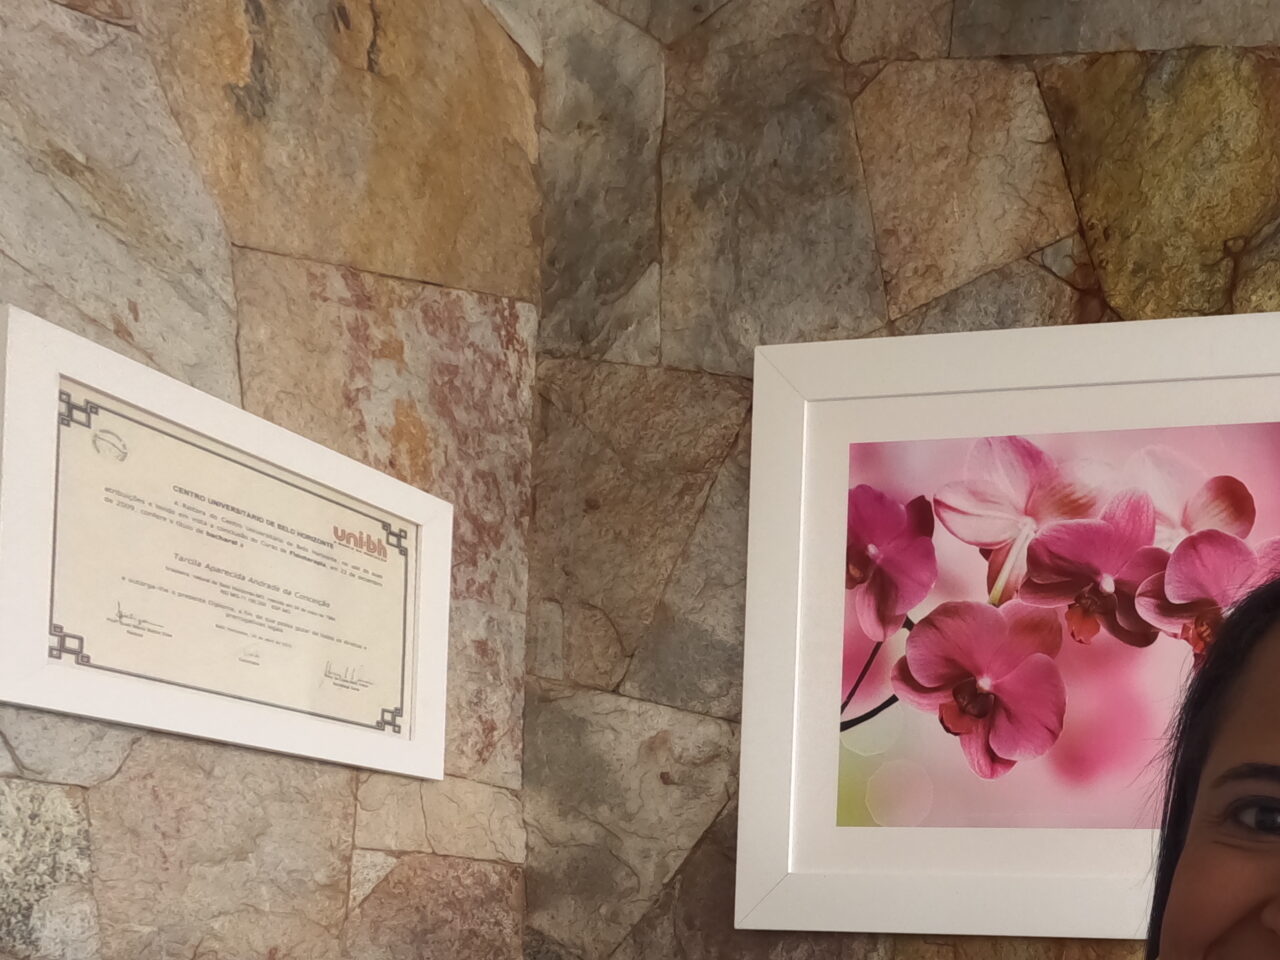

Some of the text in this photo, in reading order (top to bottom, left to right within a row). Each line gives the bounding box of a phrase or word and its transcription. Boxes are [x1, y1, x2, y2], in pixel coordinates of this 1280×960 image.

[172, 485, 205, 501] CENTRO
[277, 523, 295, 534] BELO
[296, 531, 333, 549] HORIZONTE
[174, 552, 202, 567] Tarcila
[204, 563, 246, 581] Aparecida
[247, 577, 280, 592] Andrade
[294, 591, 330, 608] Conceição
